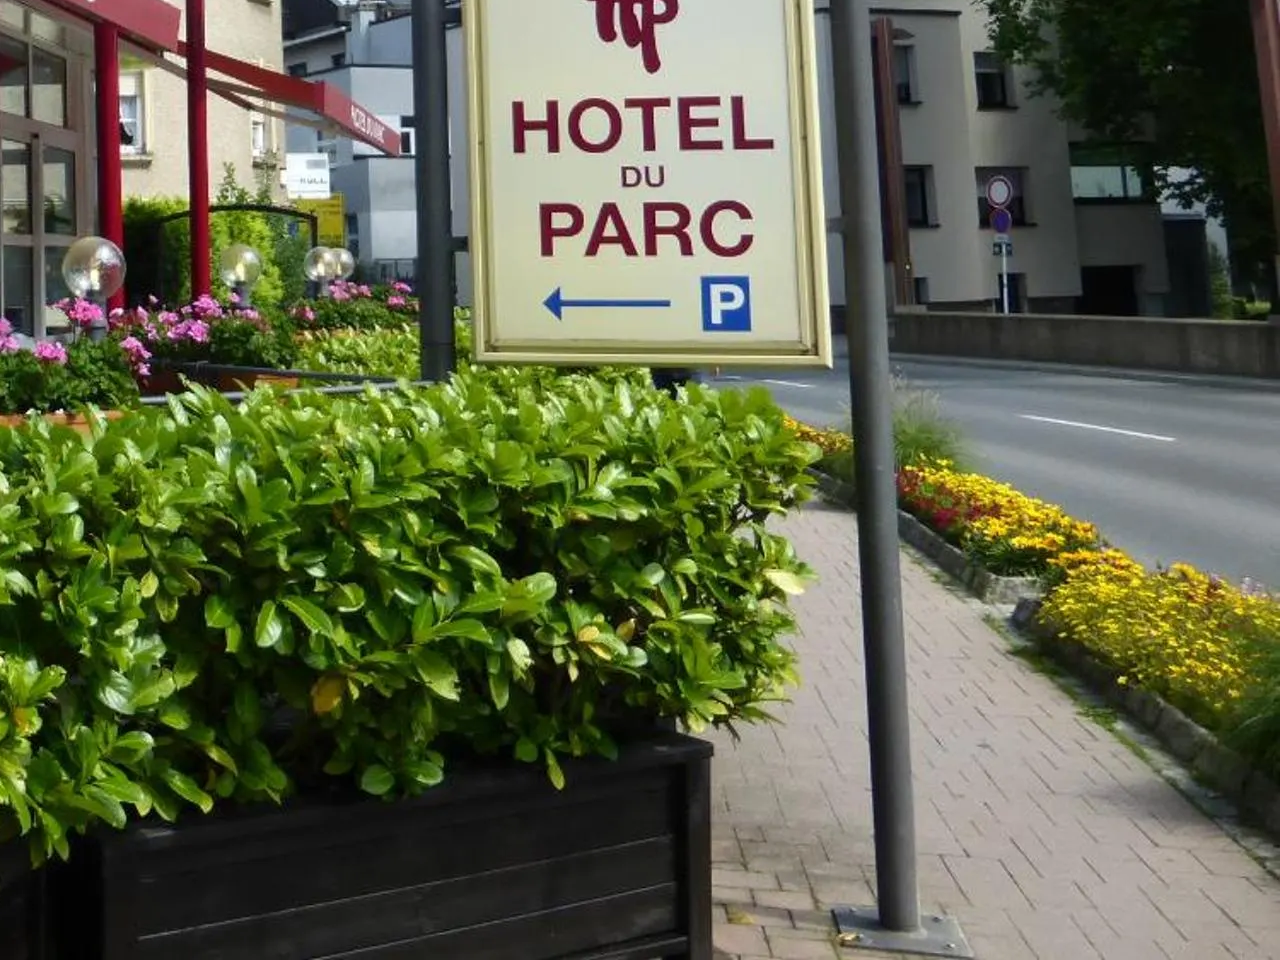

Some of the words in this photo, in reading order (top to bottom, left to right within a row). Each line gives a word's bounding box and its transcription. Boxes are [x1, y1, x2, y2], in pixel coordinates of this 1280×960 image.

[511, 96, 774, 153] HOTEL
[620, 166, 665, 188] DU
[539, 200, 754, 257] PARC
[709, 285, 745, 325] P
